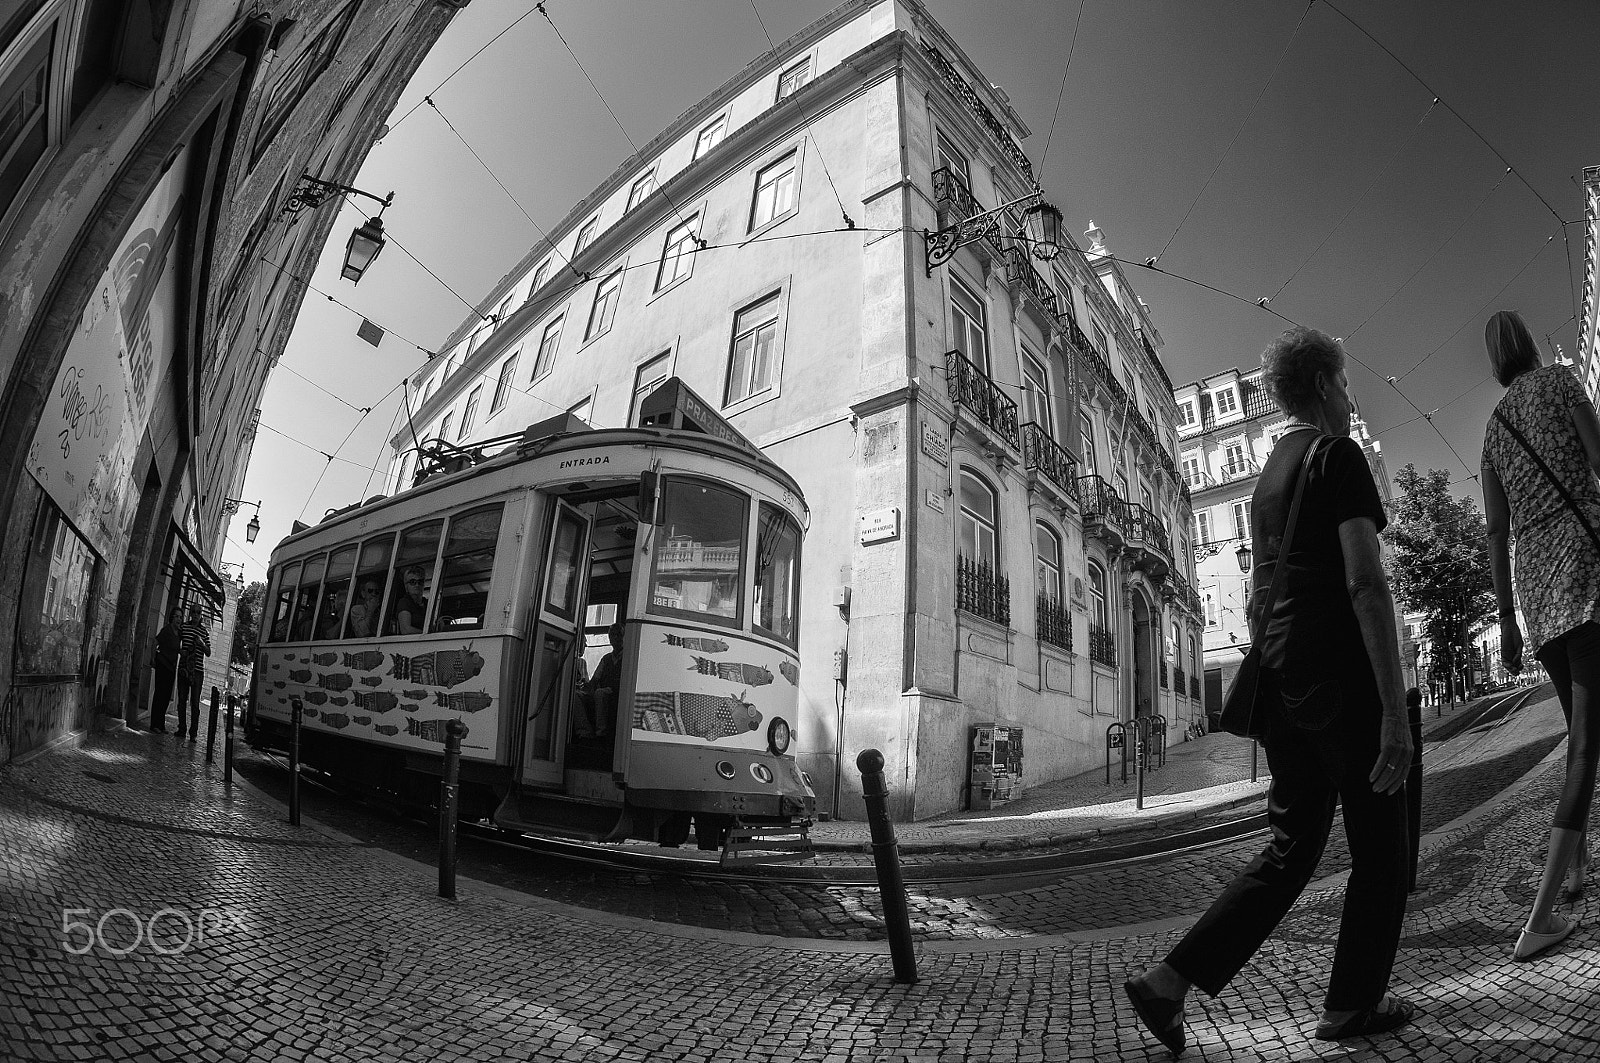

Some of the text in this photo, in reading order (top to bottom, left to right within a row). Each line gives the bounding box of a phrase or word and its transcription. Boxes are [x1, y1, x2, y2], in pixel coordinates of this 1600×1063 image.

[686, 397, 738, 444] PRAZERES
[925, 432, 946, 450] CHIADO
[560, 456, 610, 469] ENTRADA
